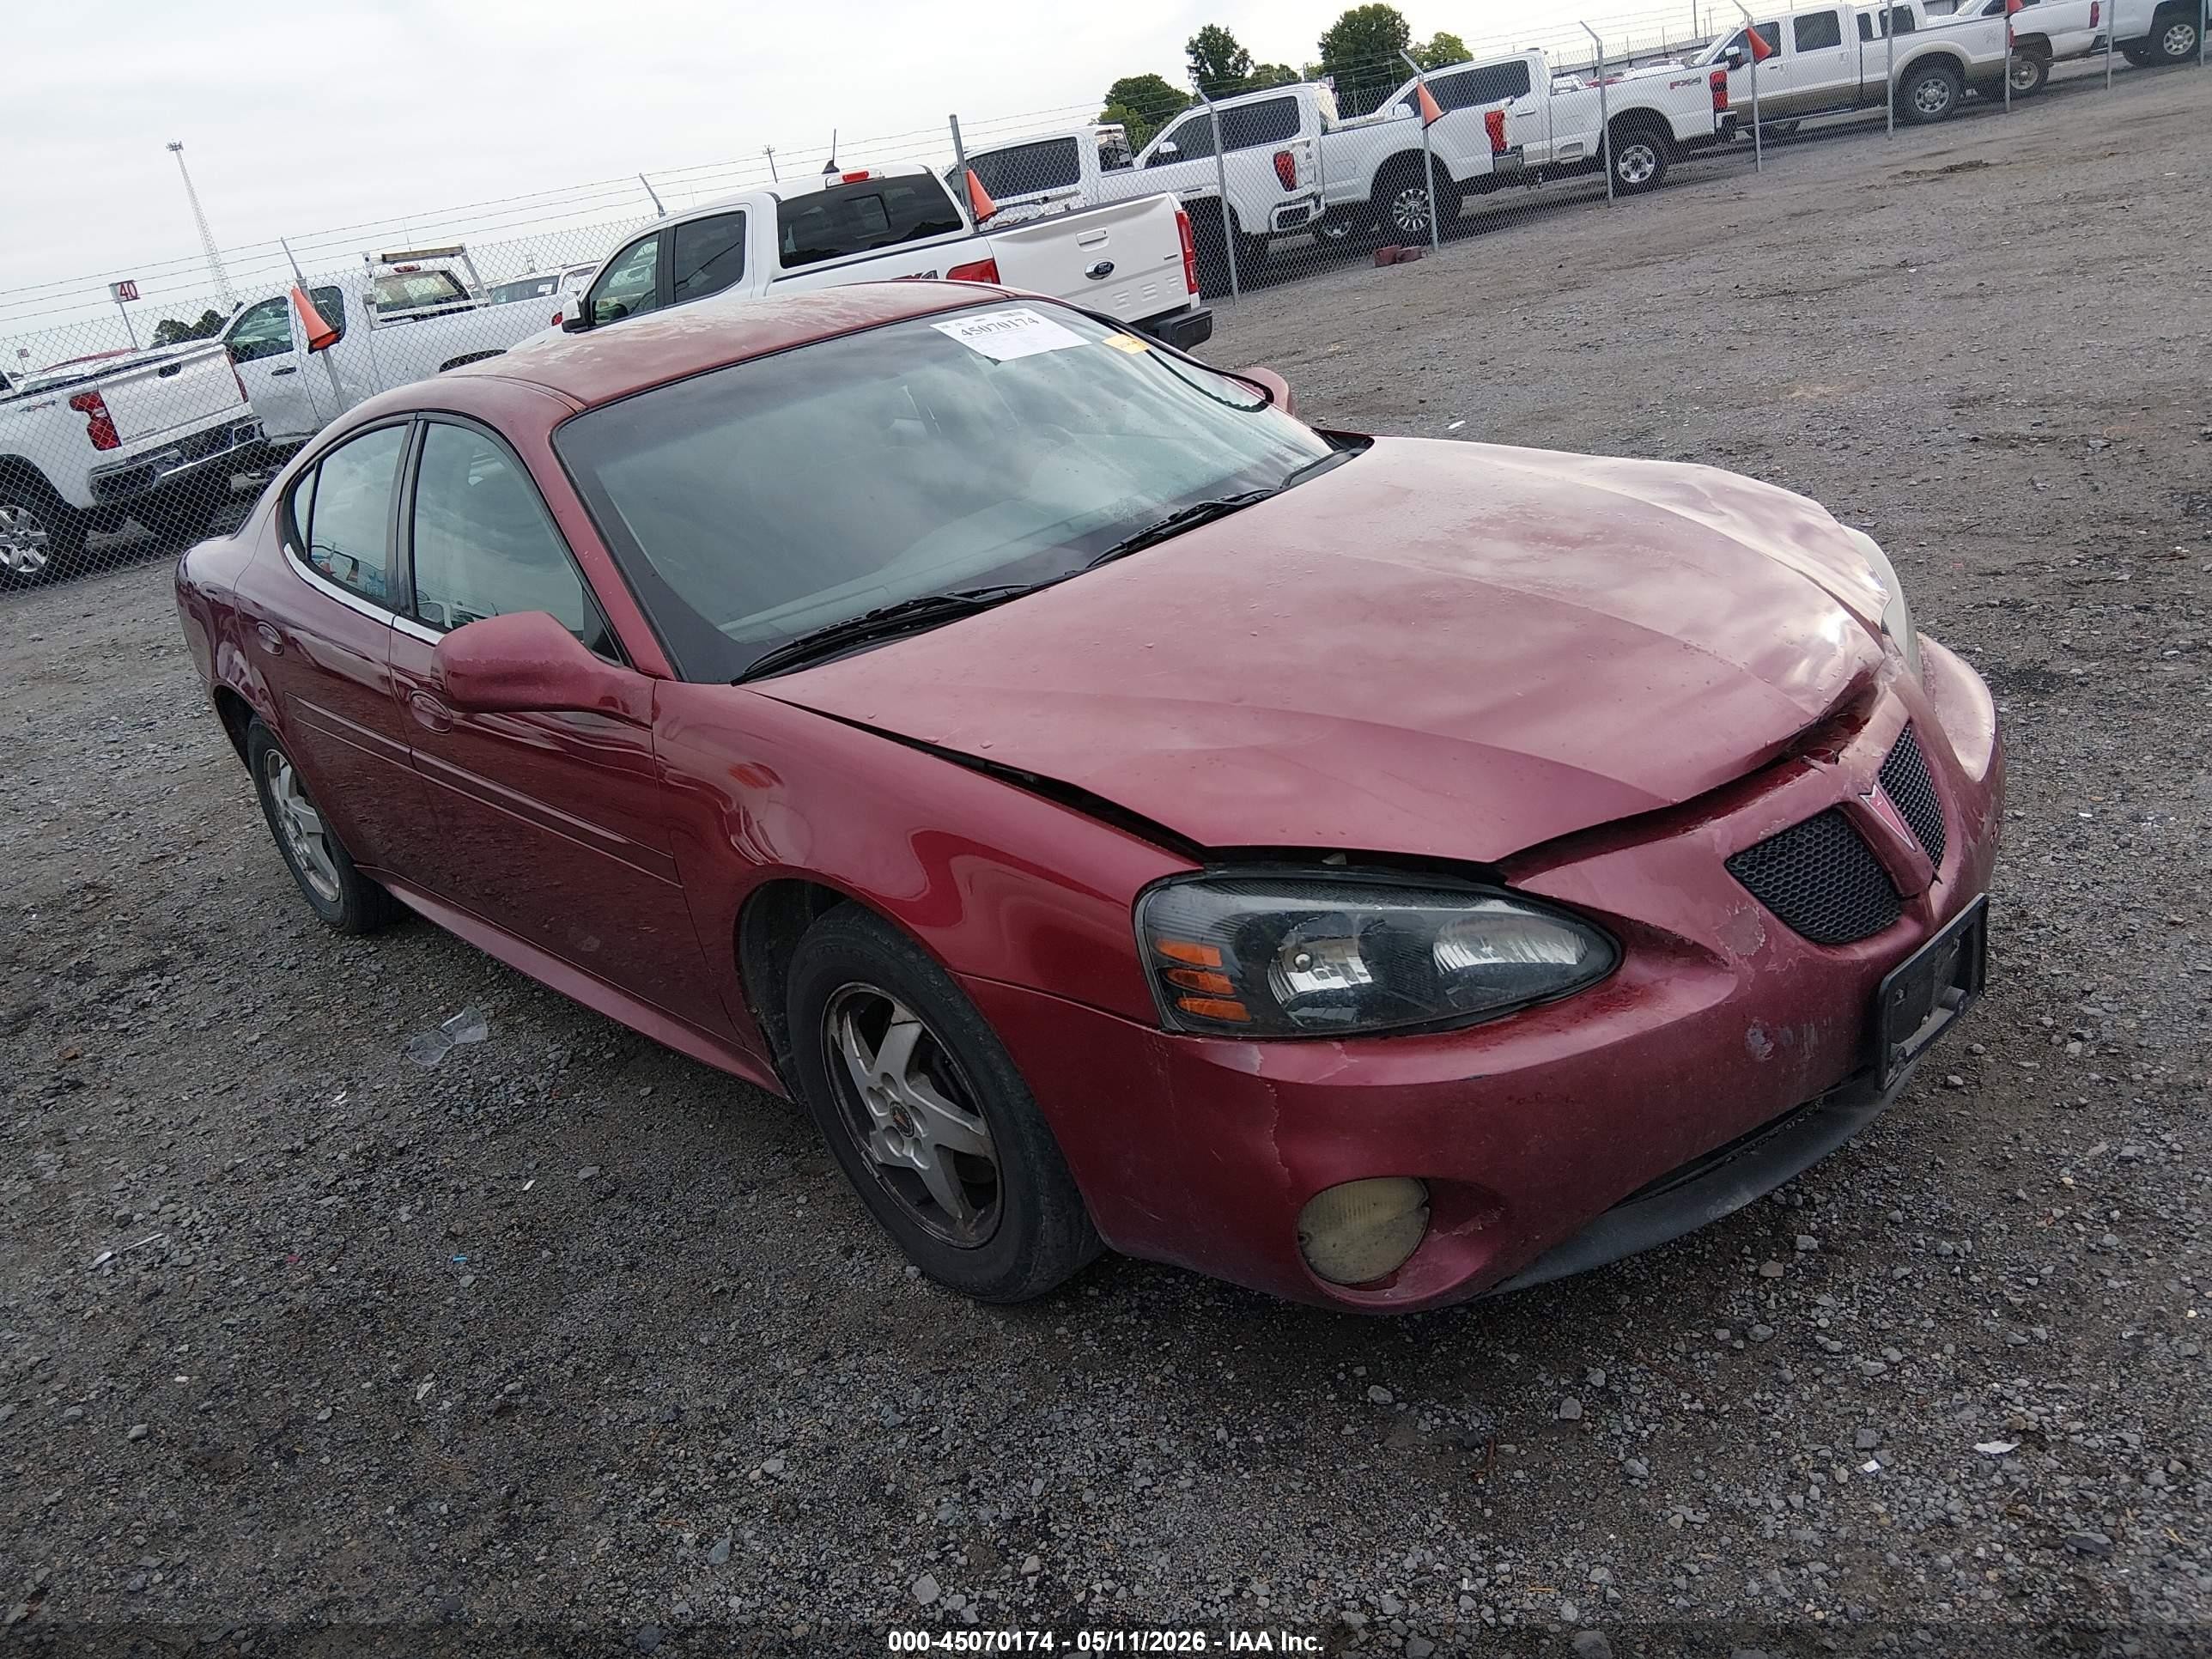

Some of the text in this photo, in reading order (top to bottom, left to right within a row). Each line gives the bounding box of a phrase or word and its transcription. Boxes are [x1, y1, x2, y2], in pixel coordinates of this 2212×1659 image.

[1669, 76, 1702, 90] FX4
[119, 281, 138, 300] 40
[960, 316, 1040, 337] 45070174
